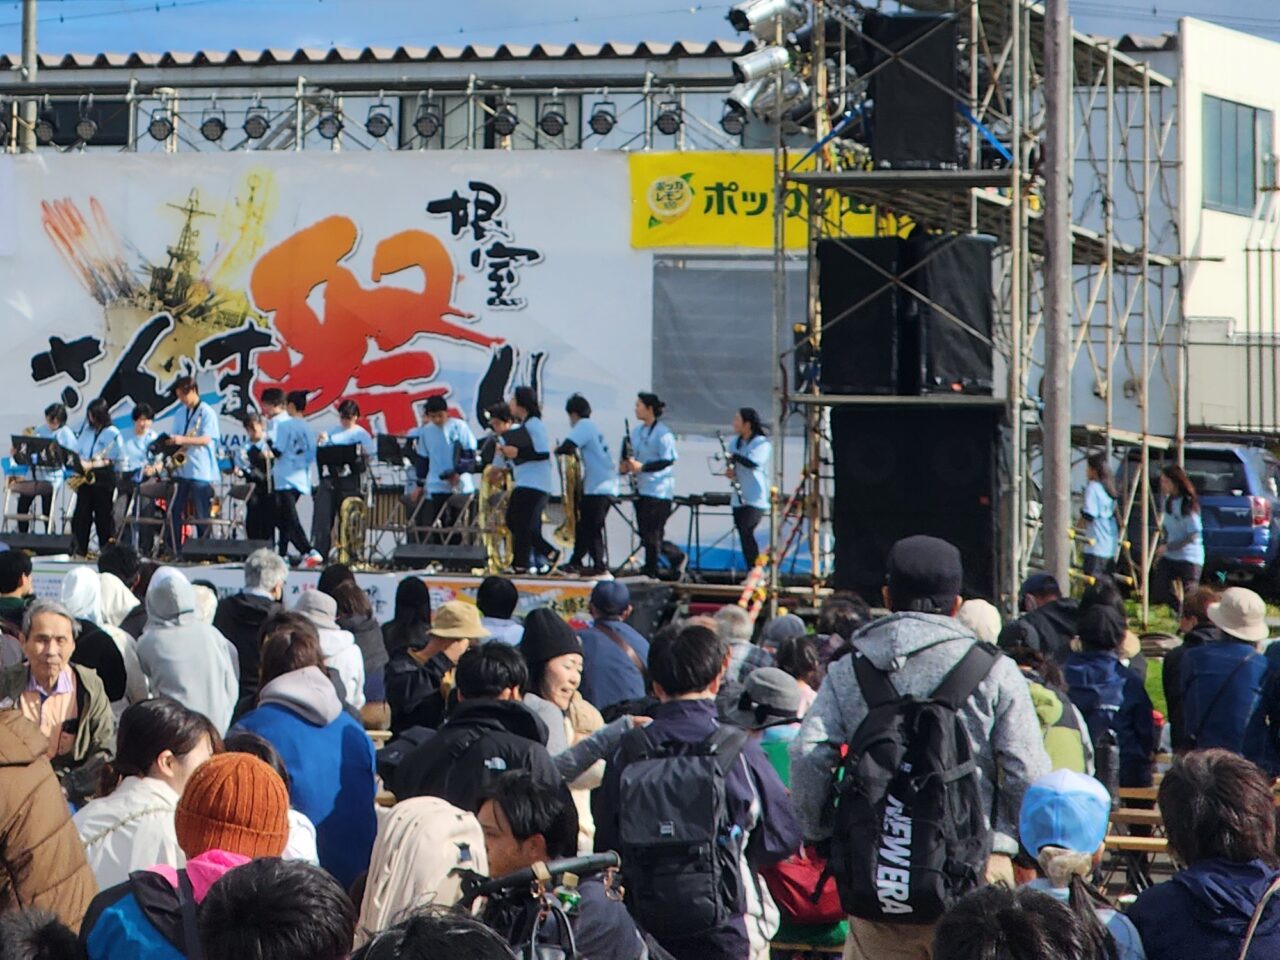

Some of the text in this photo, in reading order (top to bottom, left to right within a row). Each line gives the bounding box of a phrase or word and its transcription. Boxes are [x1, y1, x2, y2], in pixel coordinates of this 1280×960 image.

[426, 181, 540, 307] 根室
[876, 794, 914, 915] NEW ERA
